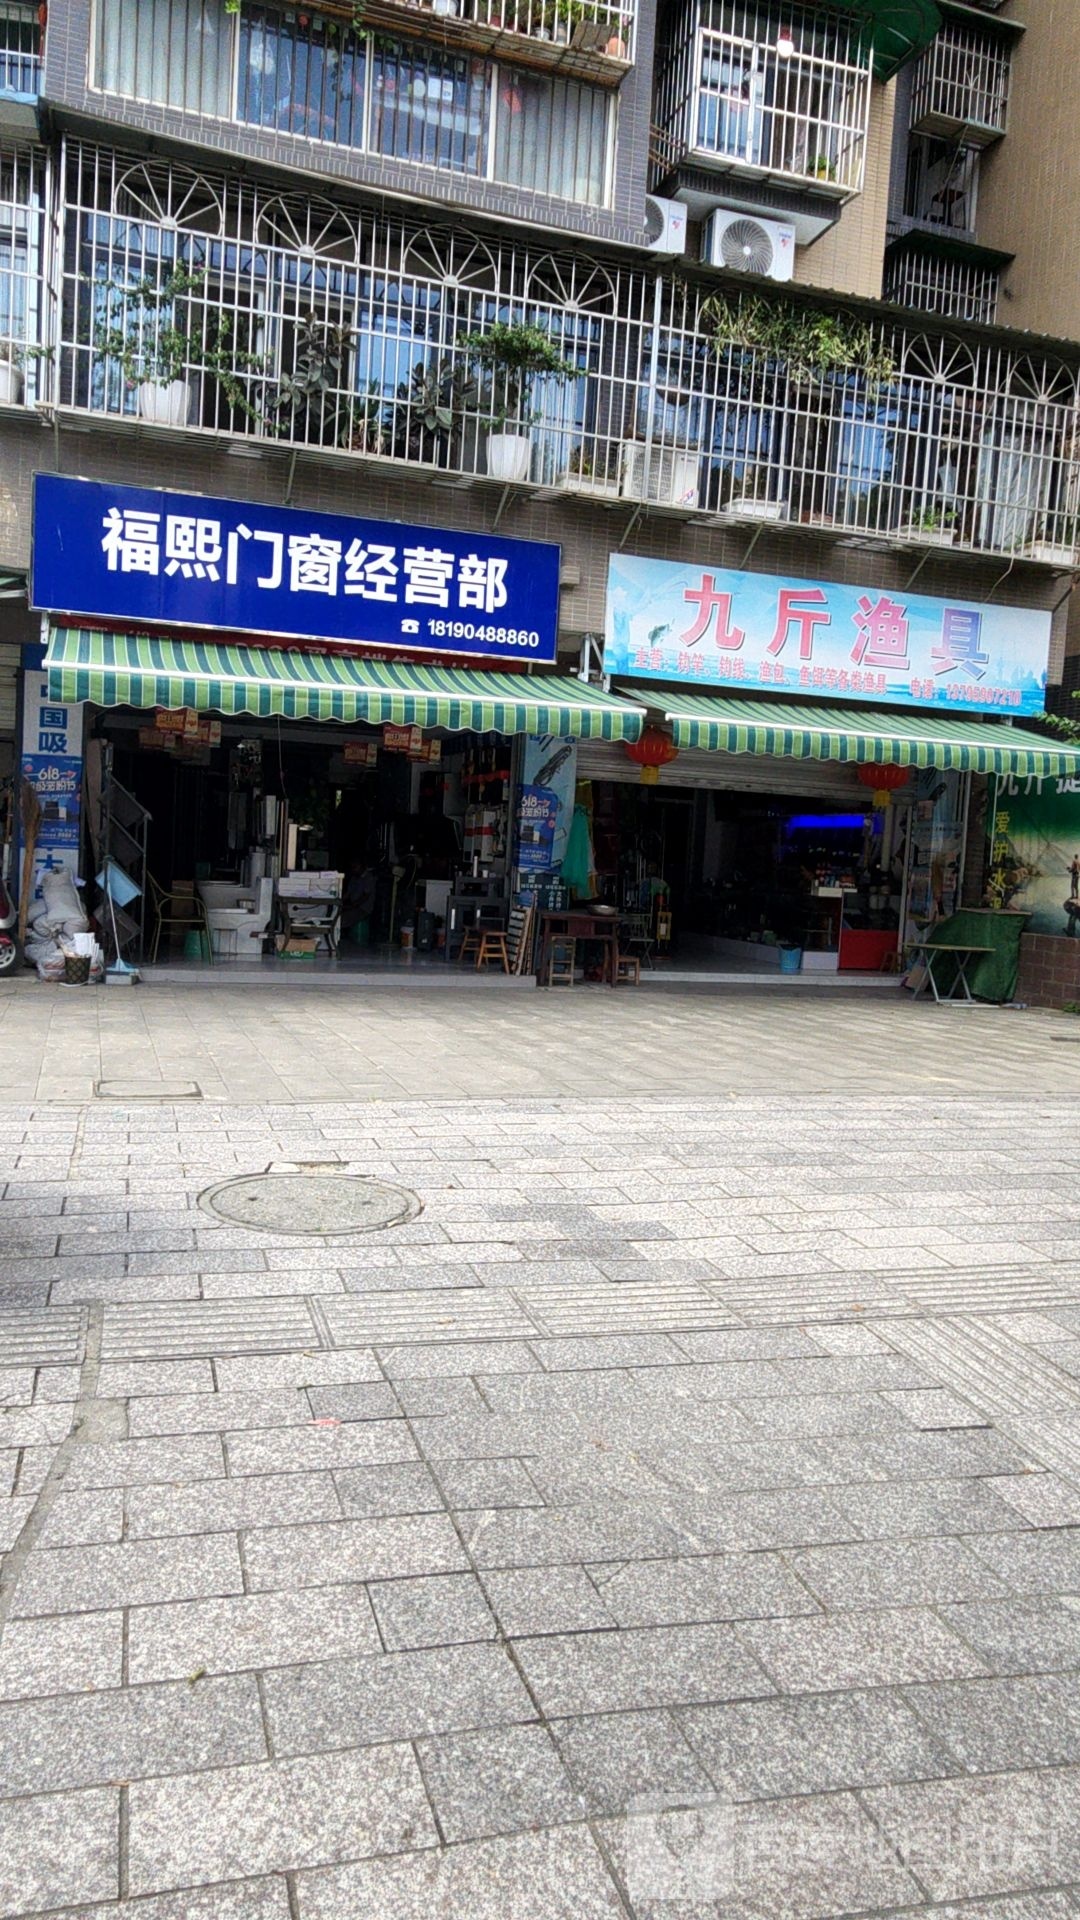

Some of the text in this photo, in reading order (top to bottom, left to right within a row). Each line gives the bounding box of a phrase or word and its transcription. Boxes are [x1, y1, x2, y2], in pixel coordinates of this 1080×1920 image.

[101, 507, 508, 613] 福熙门窗经营部
[427, 618, 540, 648] 18190488860
[679, 573, 989, 680] 九斤渔具
